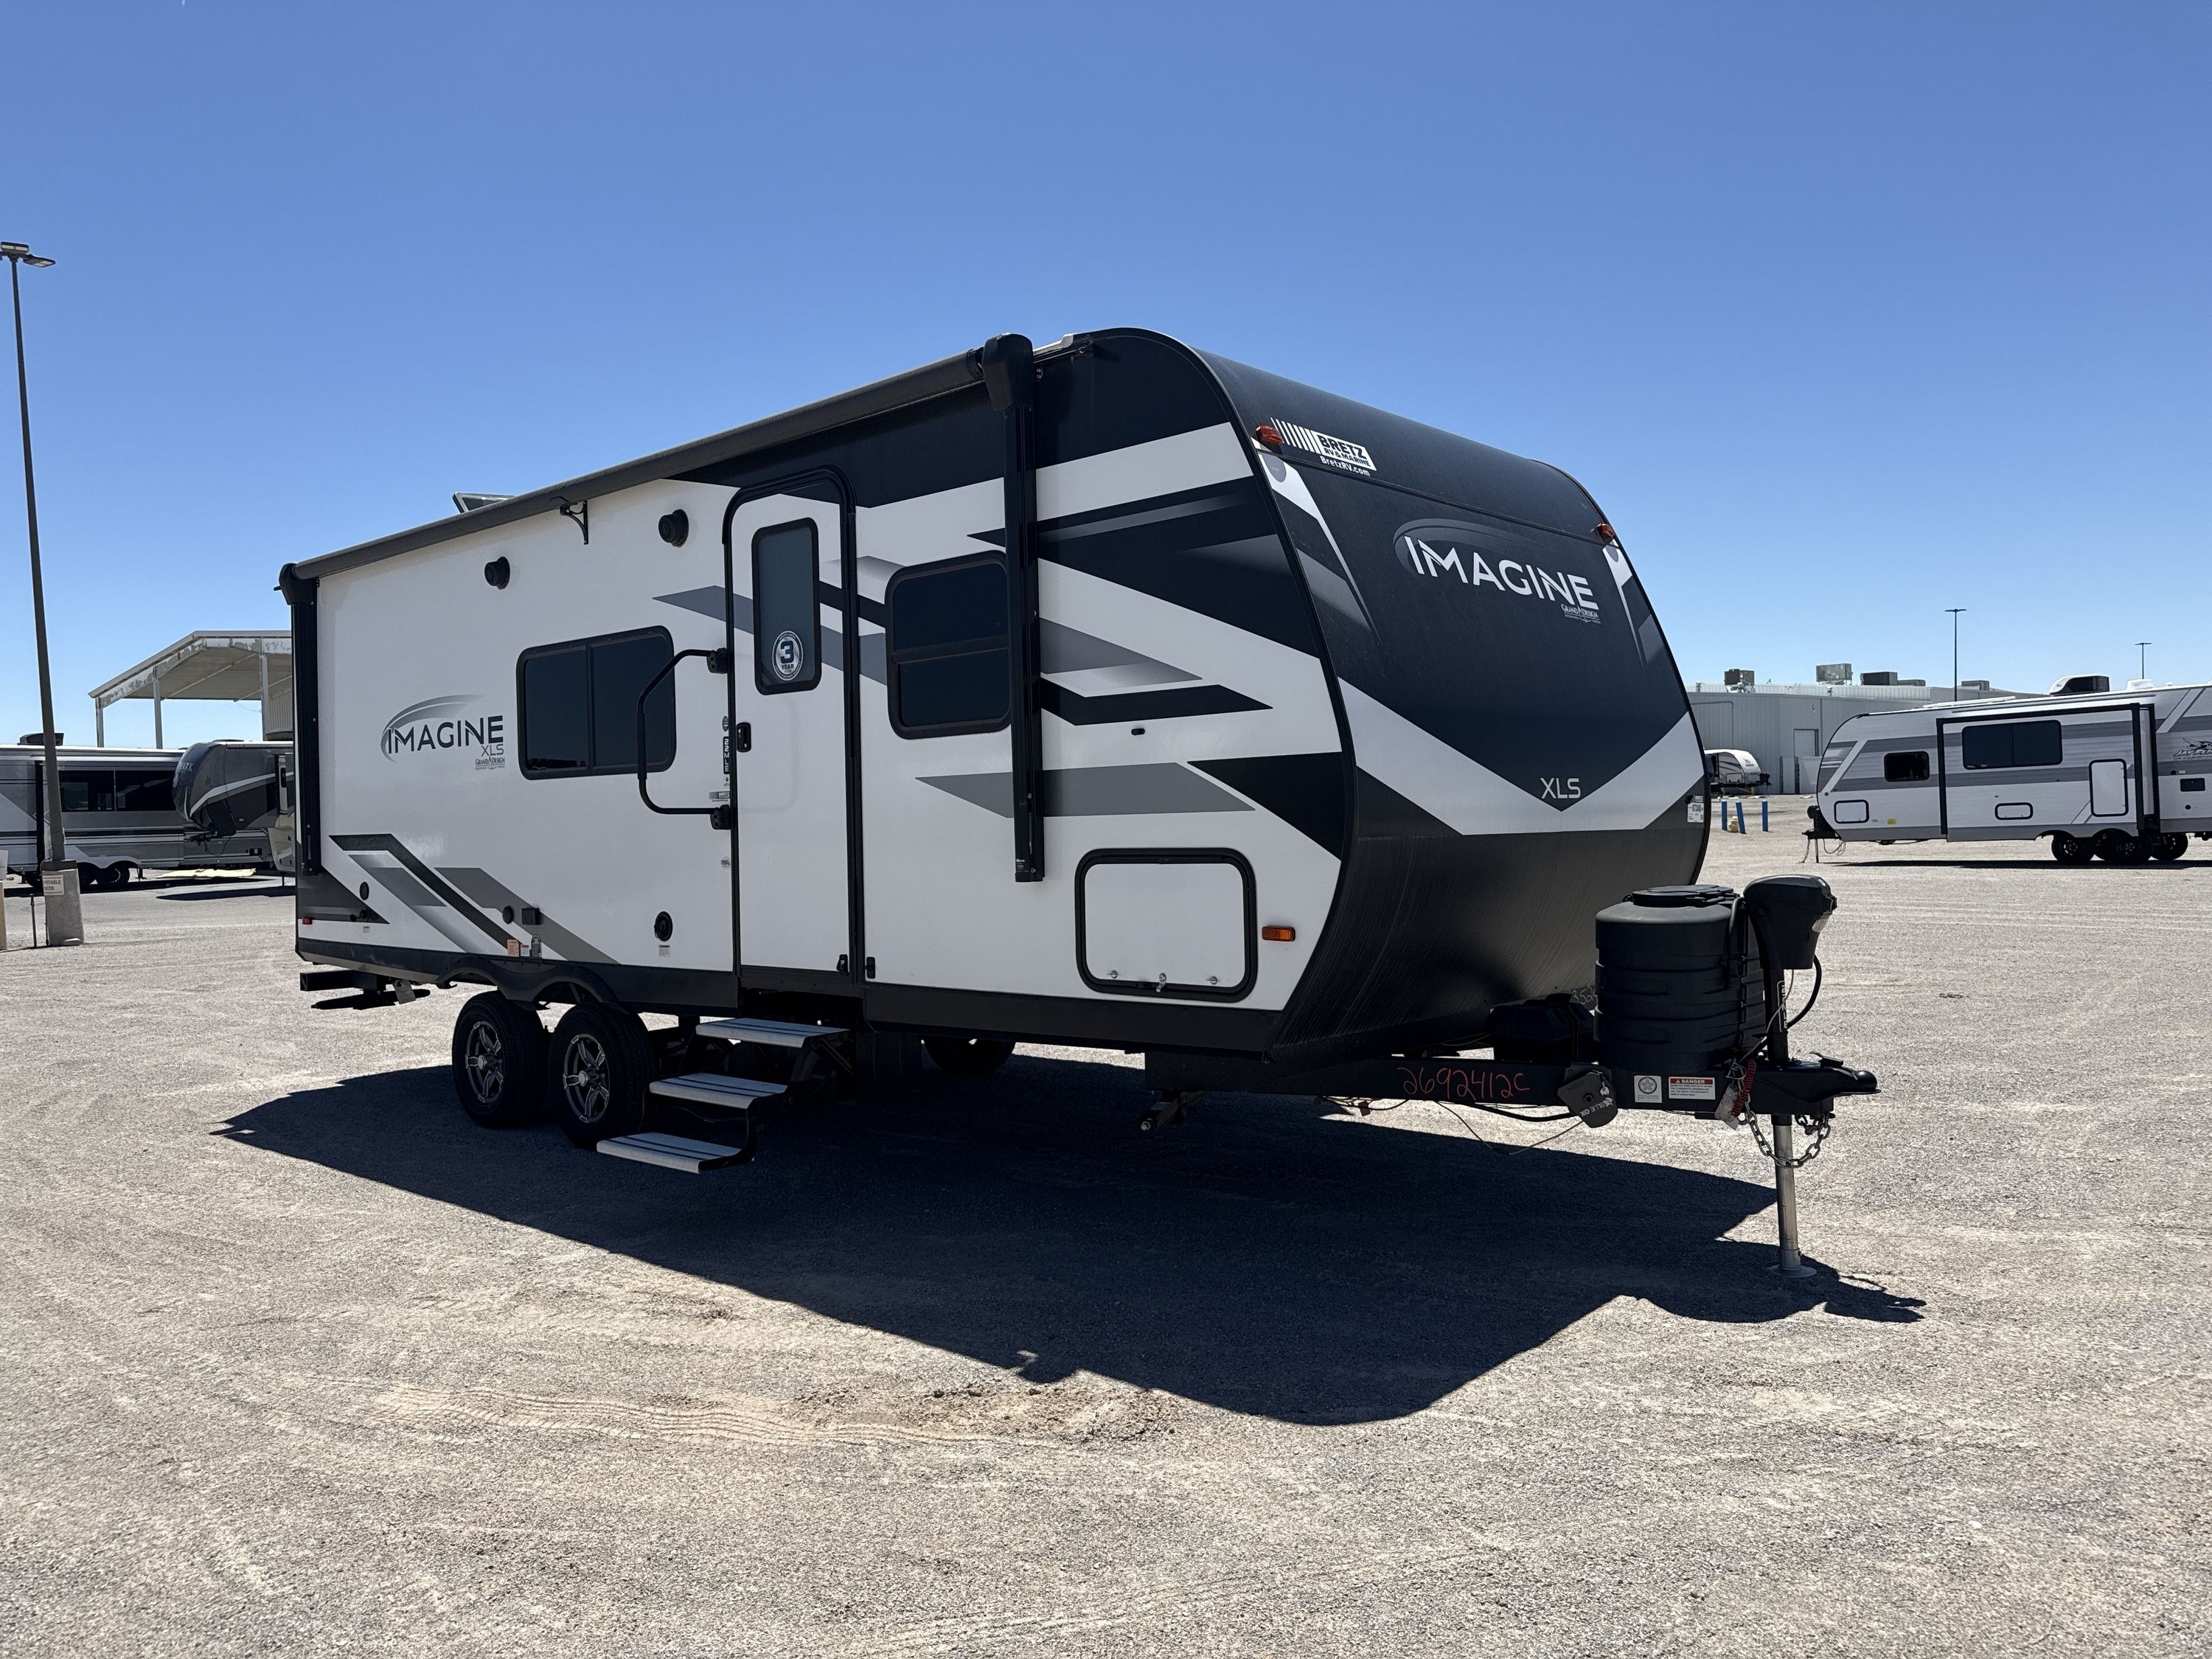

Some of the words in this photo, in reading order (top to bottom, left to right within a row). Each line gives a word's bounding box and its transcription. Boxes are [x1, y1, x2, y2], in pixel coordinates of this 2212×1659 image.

[1316, 434, 1367, 460] BRETZ
[1319, 455, 1371, 477] BretzRV.com
[1404, 535, 1599, 611] IMAGINE
[780, 640, 794, 664] 3
[388, 714, 504, 754] IMAGINE
[481, 743, 504, 757] XLS
[1540, 777, 1582, 799] XLS
[1589, 1102, 1605, 1112] BLUE
